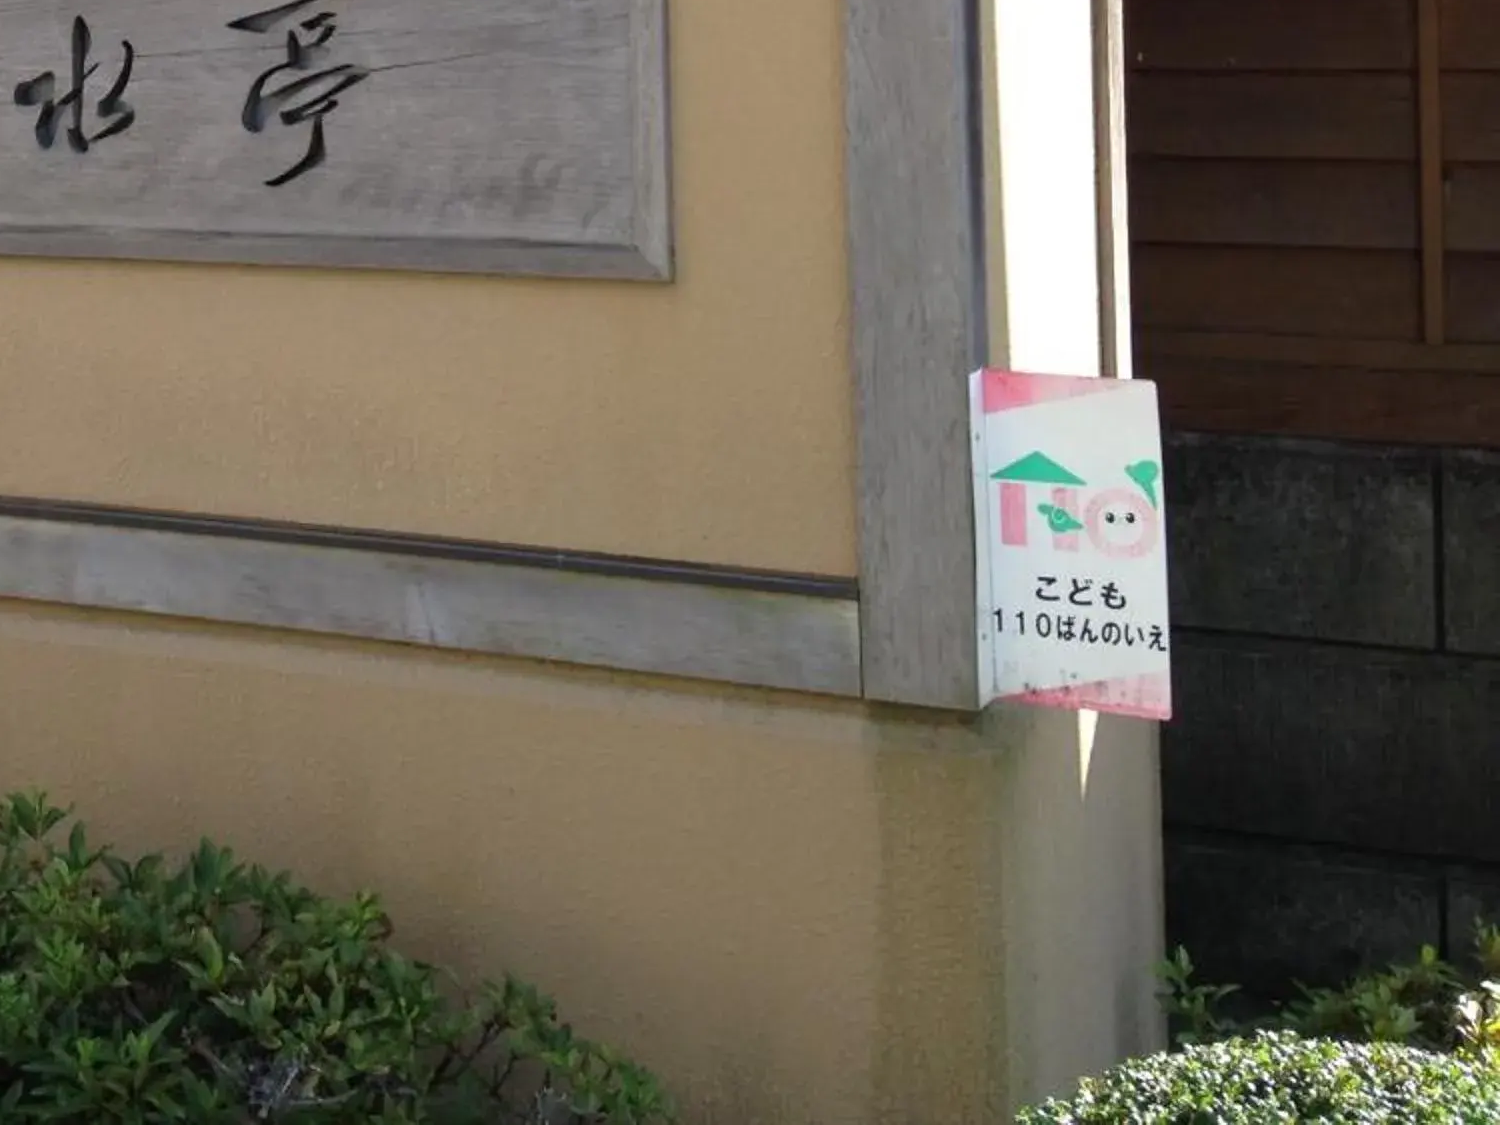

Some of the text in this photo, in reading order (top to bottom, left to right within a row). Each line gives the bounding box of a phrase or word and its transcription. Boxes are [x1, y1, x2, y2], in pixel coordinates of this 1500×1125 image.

[1036, 576, 1127, 609] こども
[994, 607, 1167, 652] 110ばんのいえ
